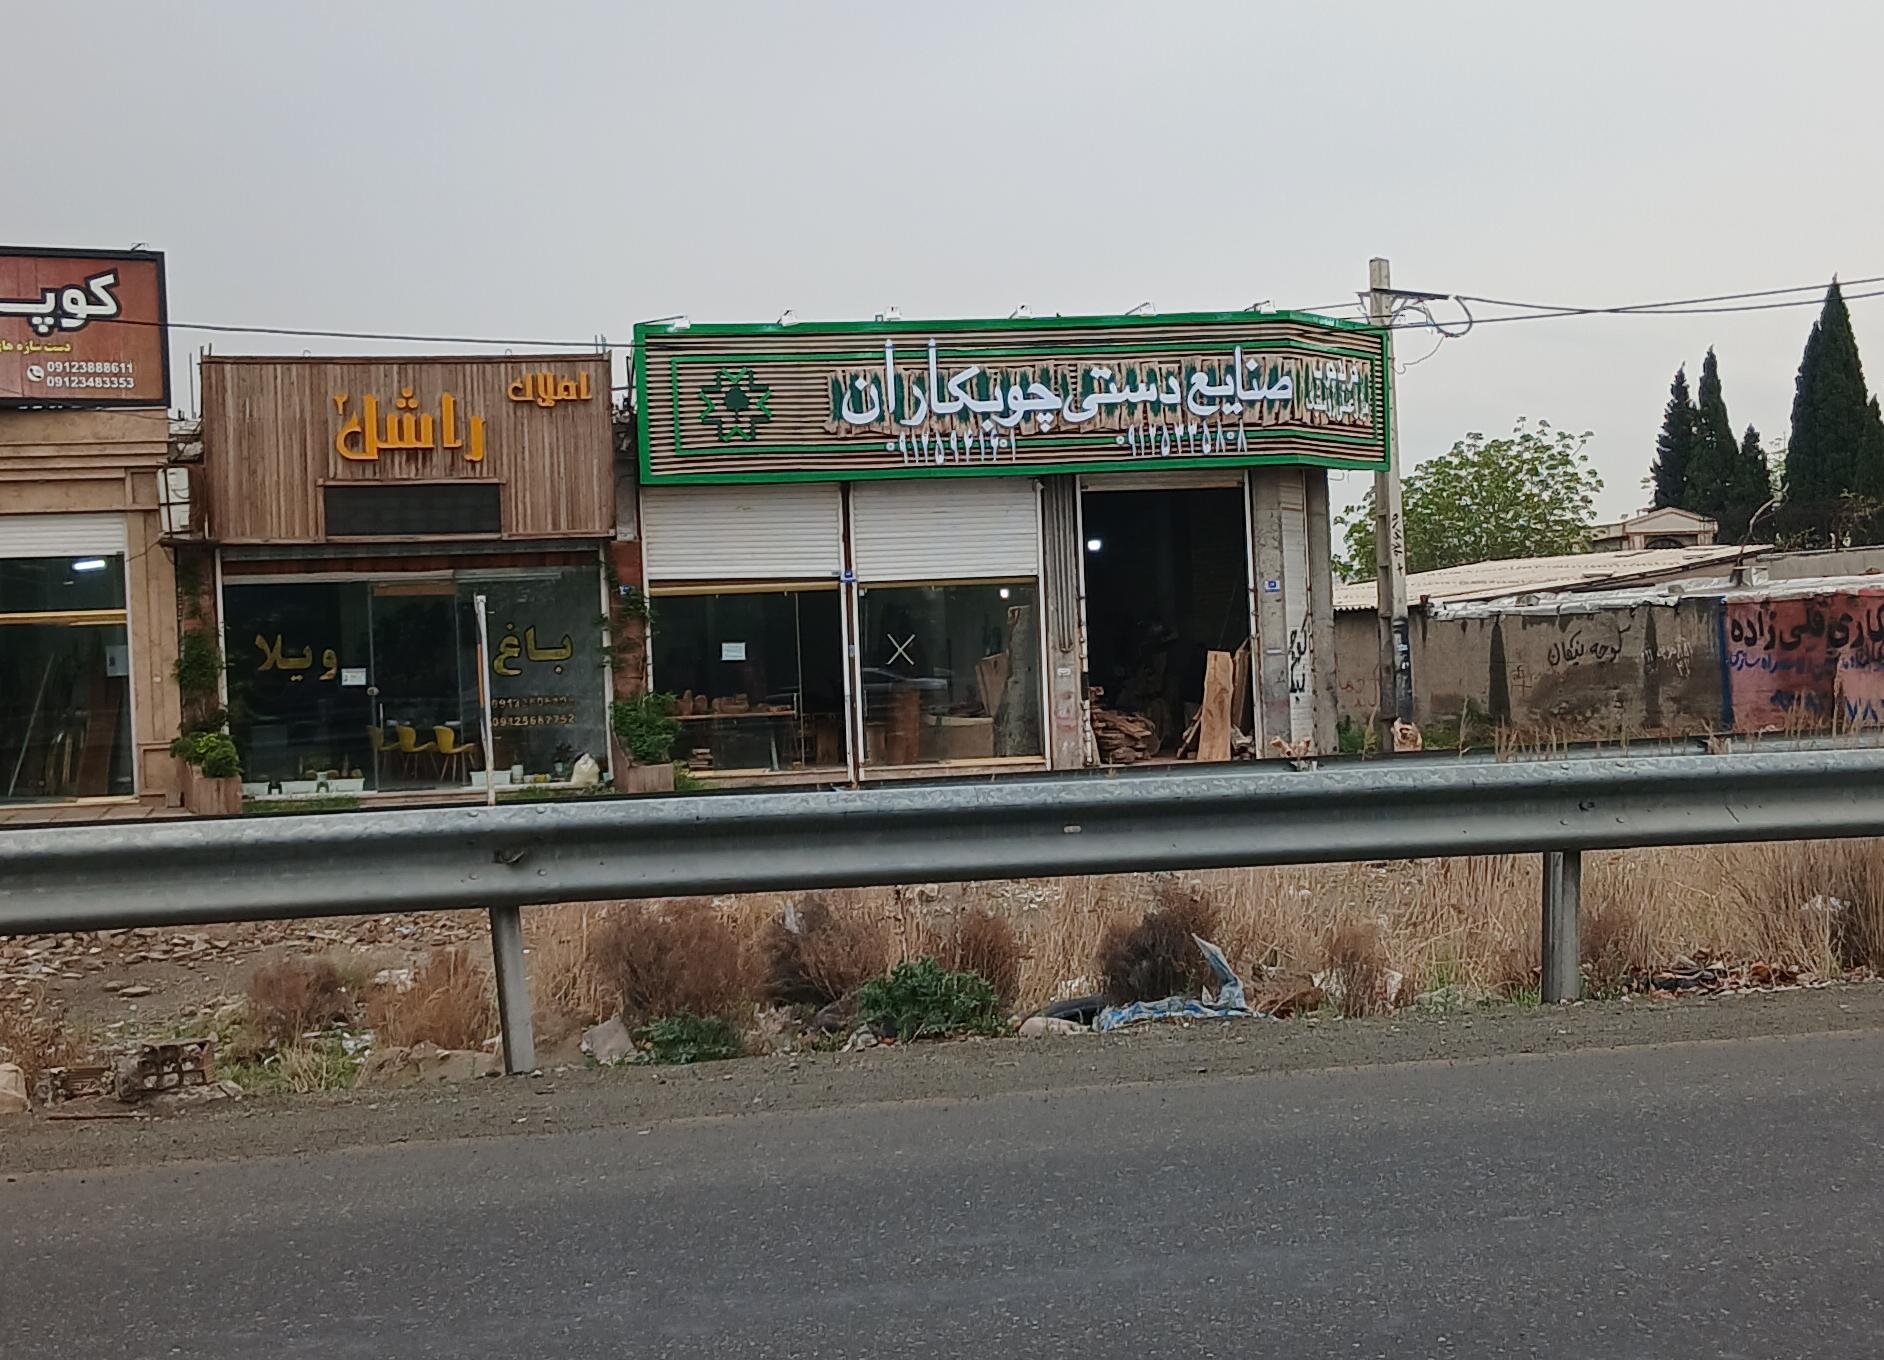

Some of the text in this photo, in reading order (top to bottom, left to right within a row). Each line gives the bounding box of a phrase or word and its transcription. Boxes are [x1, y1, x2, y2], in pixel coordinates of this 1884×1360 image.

[0, 272, 118, 334] کوپ
[46, 361, 133, 373] 09123888611
[46, 376, 134, 388] 09123483353
[507, 372, 592, 407] املاک
[841, 338, 1063, 433] چوبکاران
[1062, 366, 1182, 423] دستی
[1186, 345, 1293, 416] صنایع
[255, 623, 574, 681] باغ ویلا
